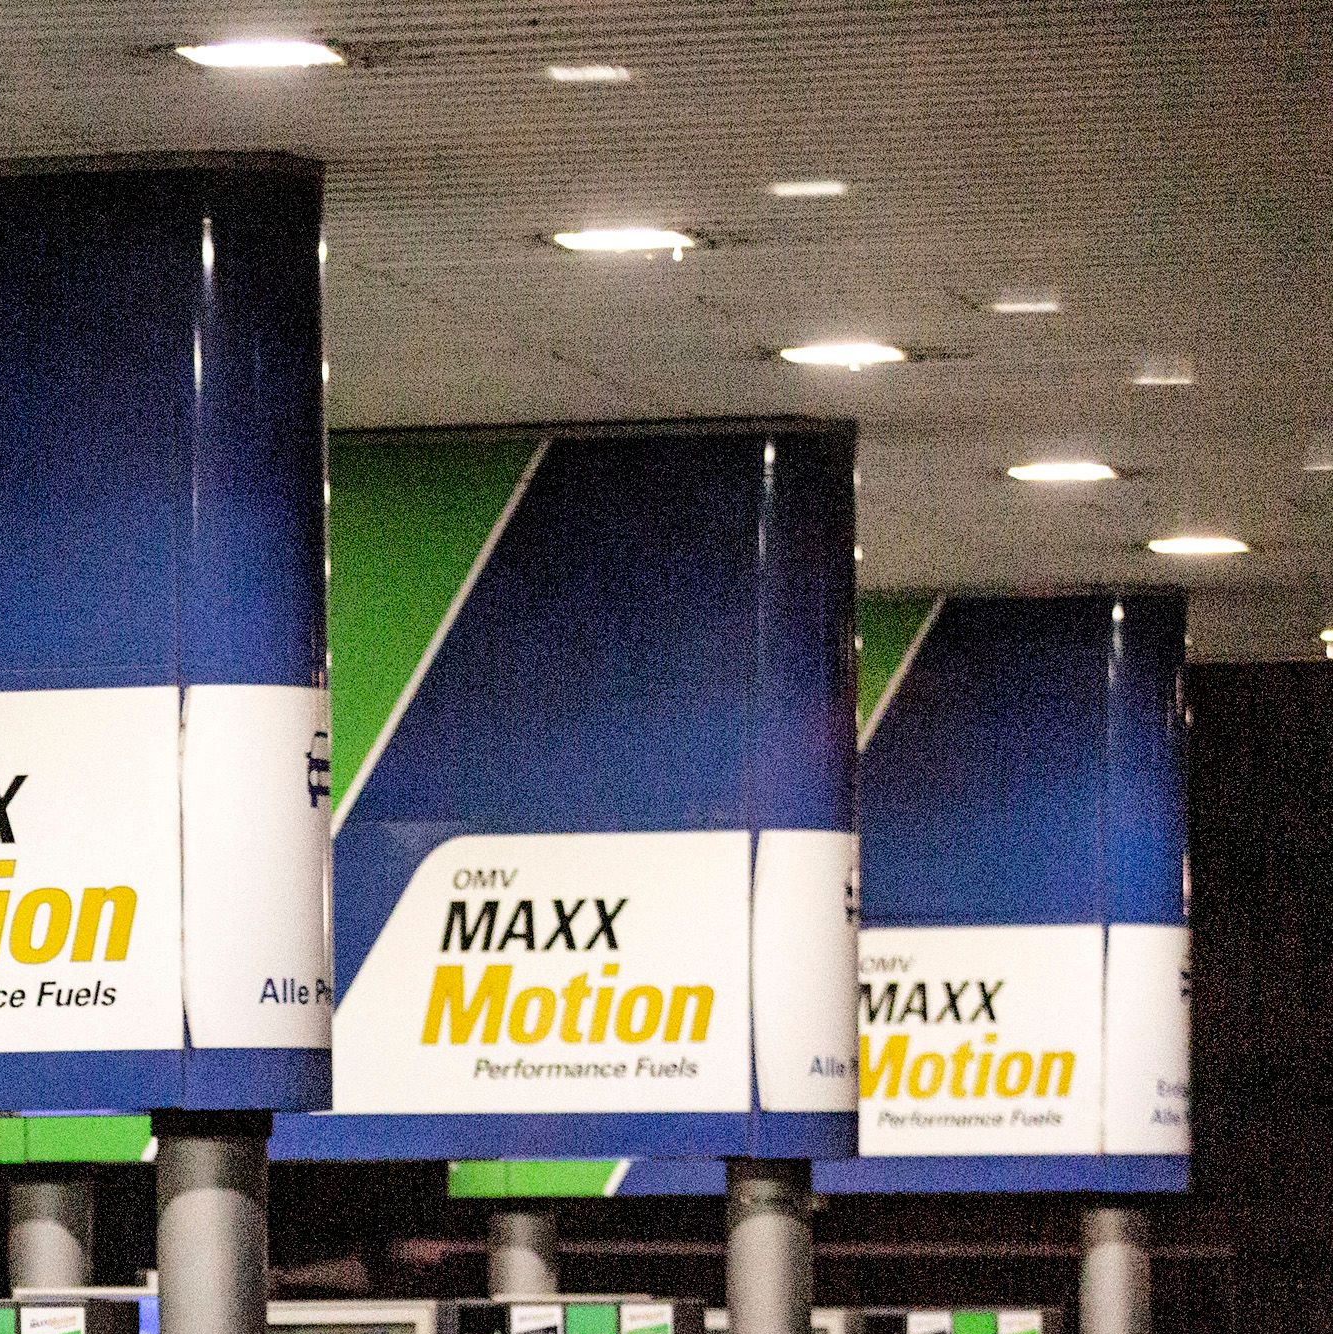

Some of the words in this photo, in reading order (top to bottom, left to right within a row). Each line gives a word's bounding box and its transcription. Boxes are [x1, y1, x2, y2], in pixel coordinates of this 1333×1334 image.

[453, 868, 518, 890] OMV
[439, 897, 629, 952] MAXX
[35, 981, 117, 1009] Fuels
[260, 978, 309, 1004] Alle
[421, 963, 714, 1045] Motion
[859, 979, 1004, 1024] MAXX
[473, 1058, 627, 1080] Performance
[635, 1056, 699, 1079] Fuels
[859, 1033, 1076, 1099] Motion
